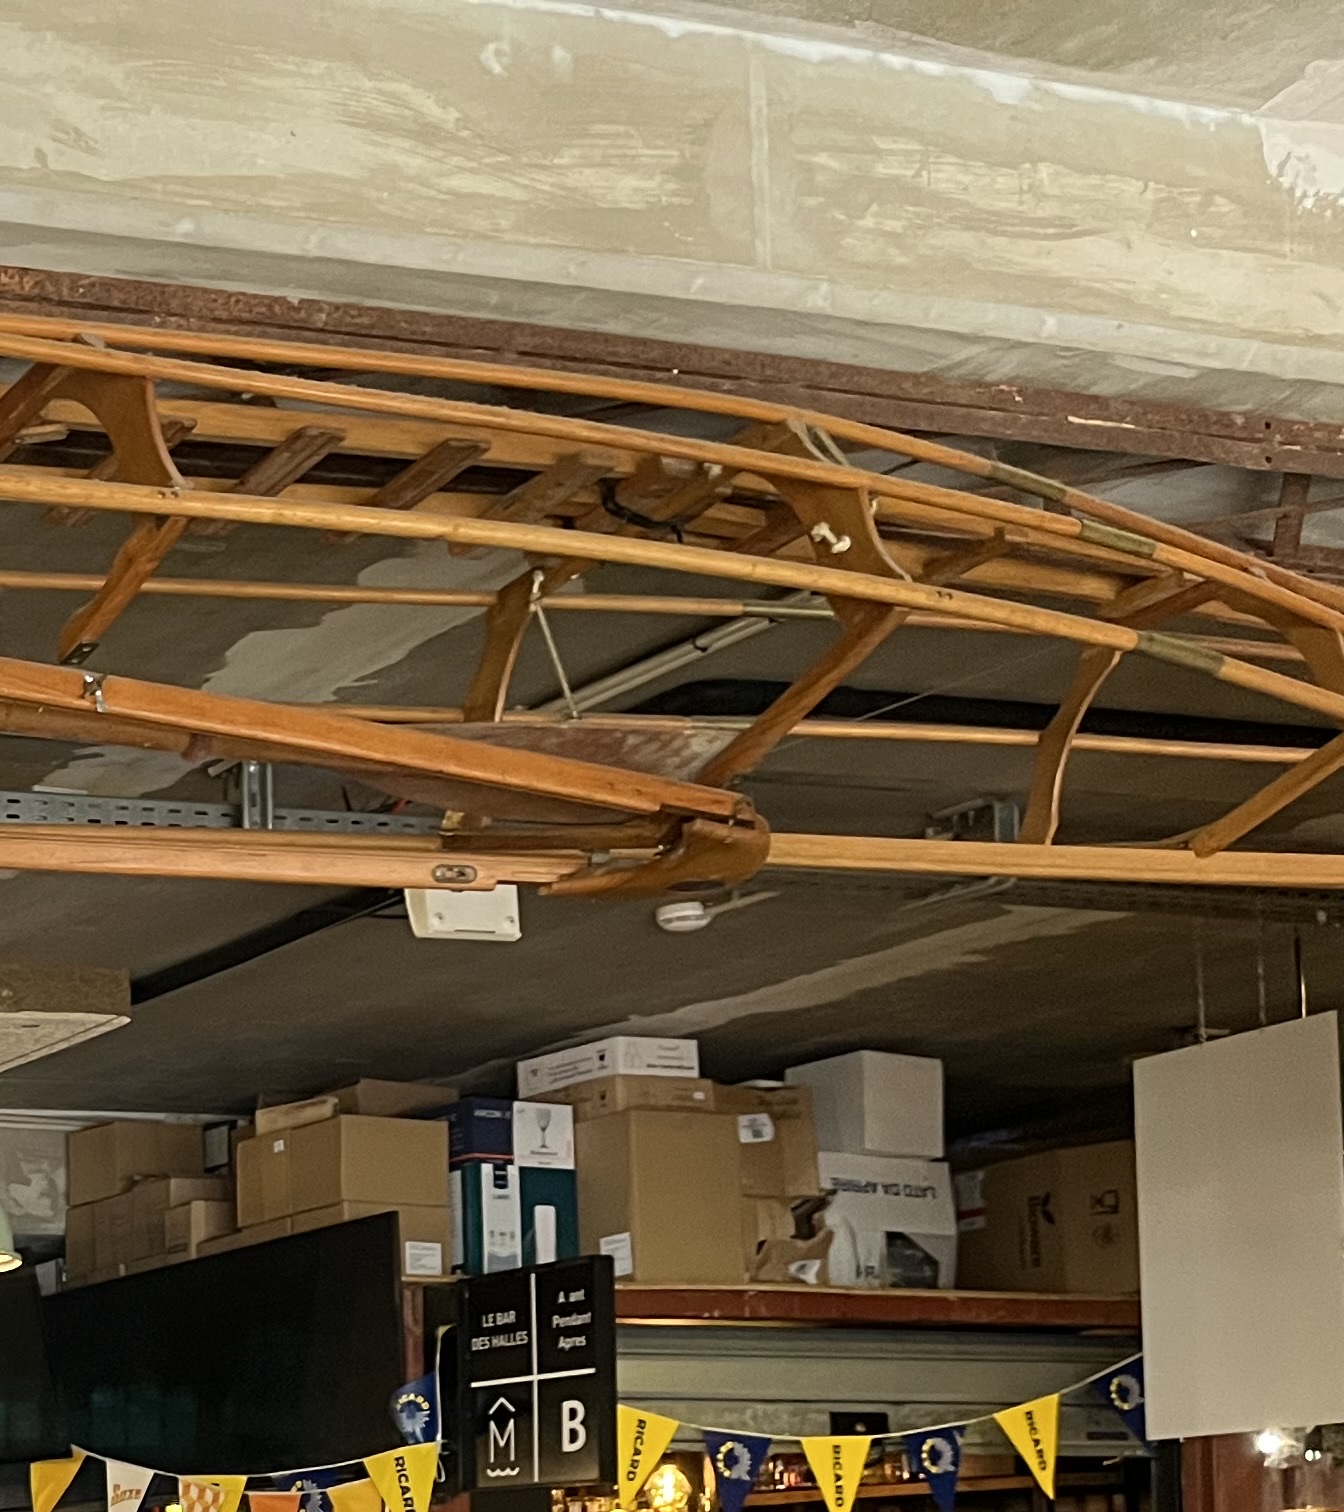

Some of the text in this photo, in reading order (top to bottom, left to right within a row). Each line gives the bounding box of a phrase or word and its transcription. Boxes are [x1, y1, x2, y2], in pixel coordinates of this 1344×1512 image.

[471, 1330, 529, 1351] DES HALLES
[481, 1310, 516, 1328] LE BAR
[562, 1400, 586, 1452] B
[627, 1418, 646, 1483] RICARD
[831, 1444, 844, 1508] RICARD
